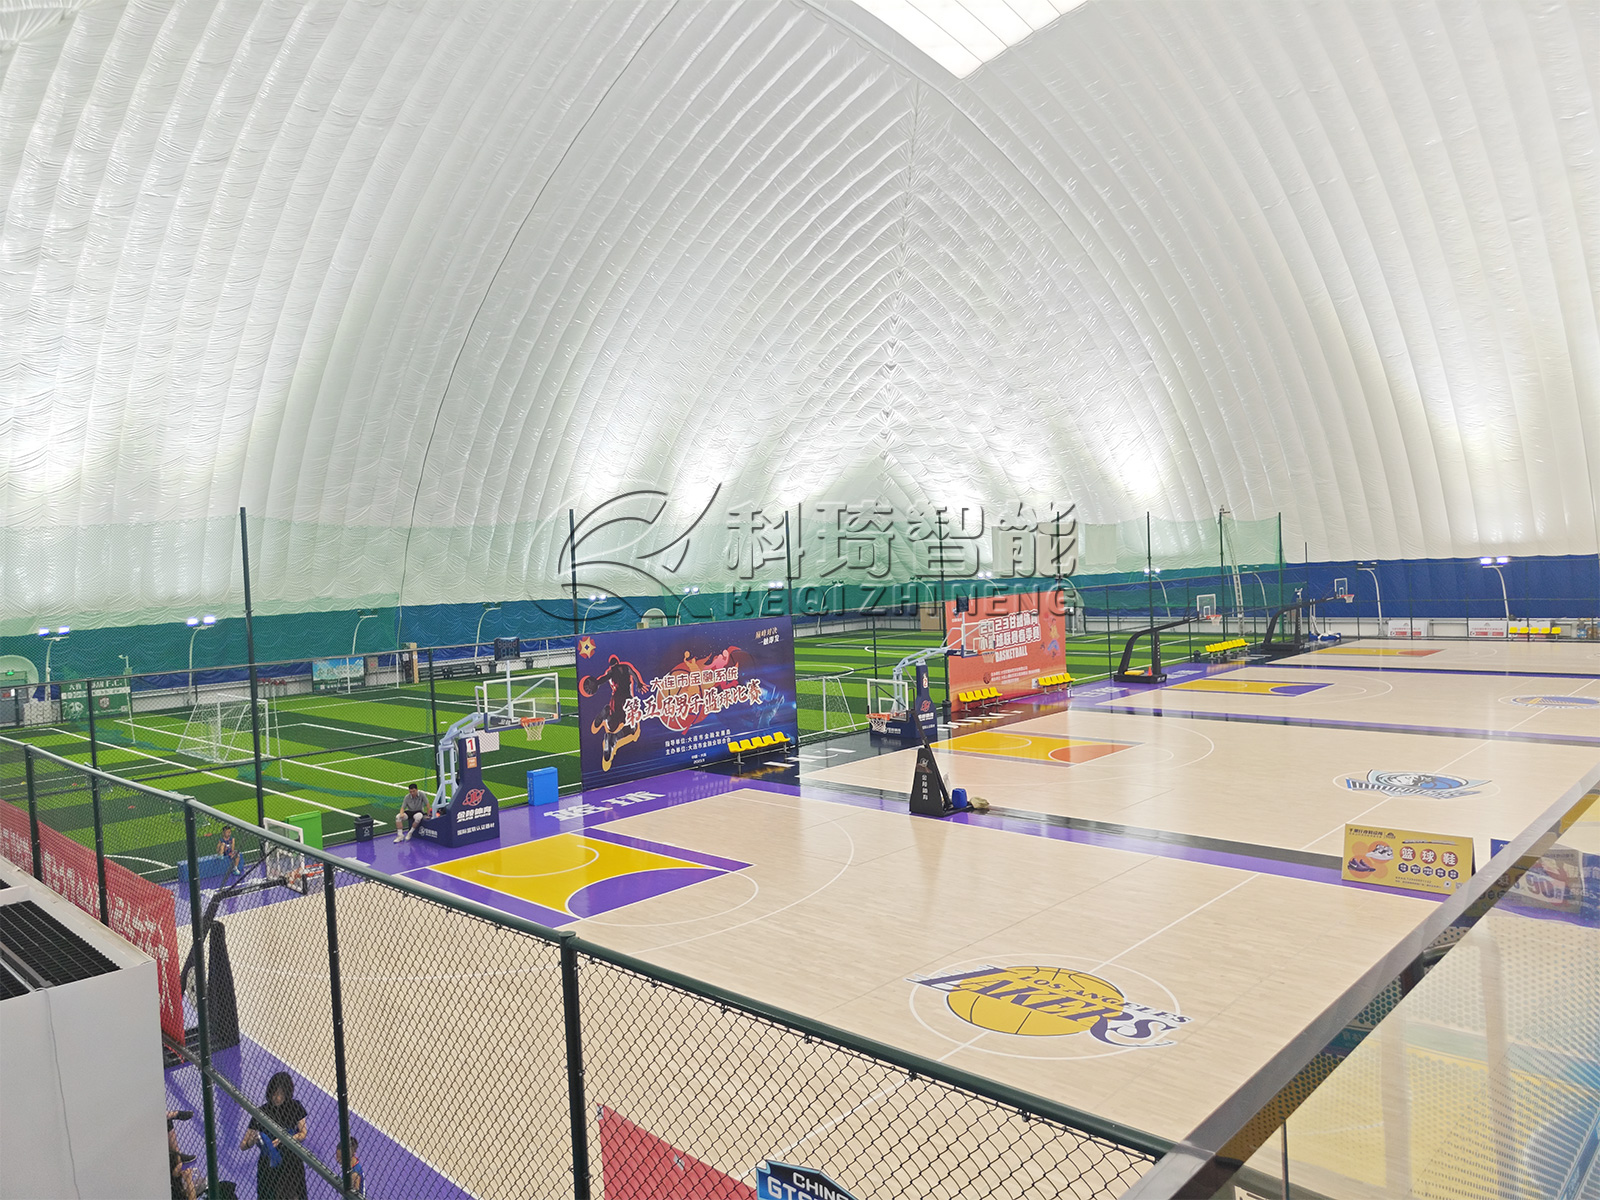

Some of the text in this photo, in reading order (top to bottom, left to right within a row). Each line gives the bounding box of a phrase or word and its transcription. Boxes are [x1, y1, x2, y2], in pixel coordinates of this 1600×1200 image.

[995, 645, 1028, 662] BASKETBALL
[650, 666, 738, 692] 大连市金融系统
[622, 679, 763, 729] 第五届男子篮球比赛
[467, 739, 474, 751] 1
[906, 964, 1178, 1047] LAKERS
[1017, 975, 1192, 1025] LOS ANGELES
